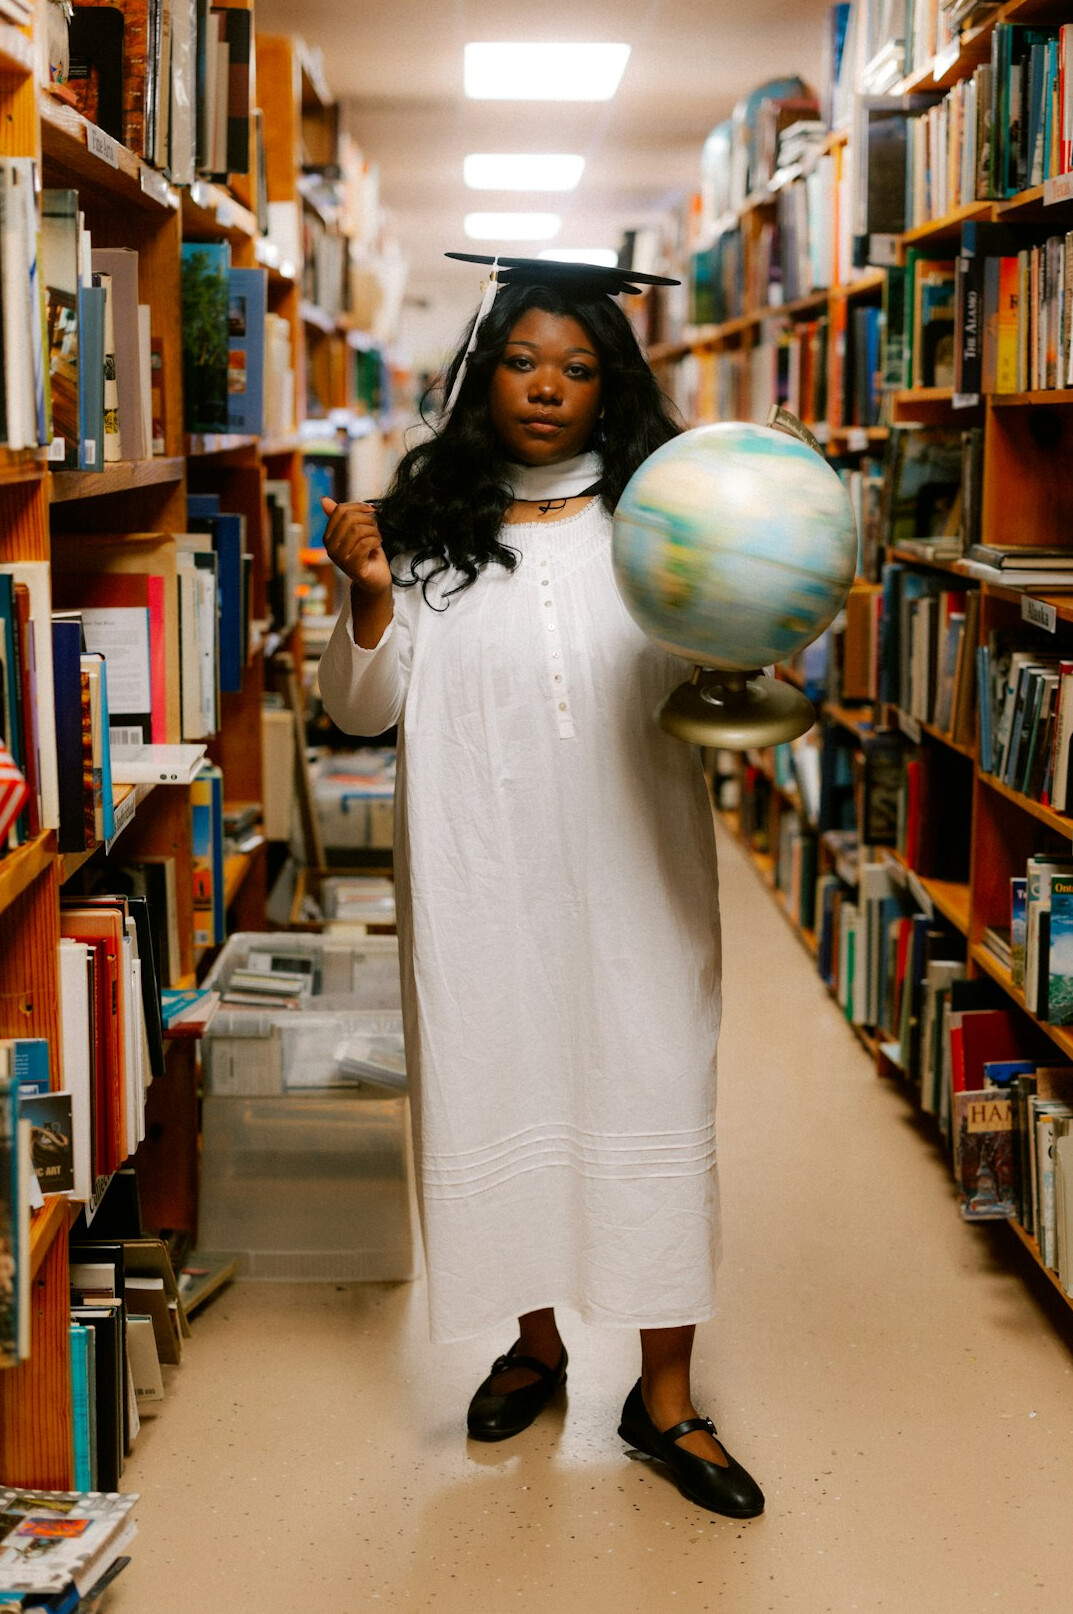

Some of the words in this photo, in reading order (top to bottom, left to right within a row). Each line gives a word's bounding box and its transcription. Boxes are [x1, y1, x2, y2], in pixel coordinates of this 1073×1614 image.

[964, 290, 977, 335] ALAMO
[965, 338, 977, 361] THE
[45, 1165, 61, 1176] ART
